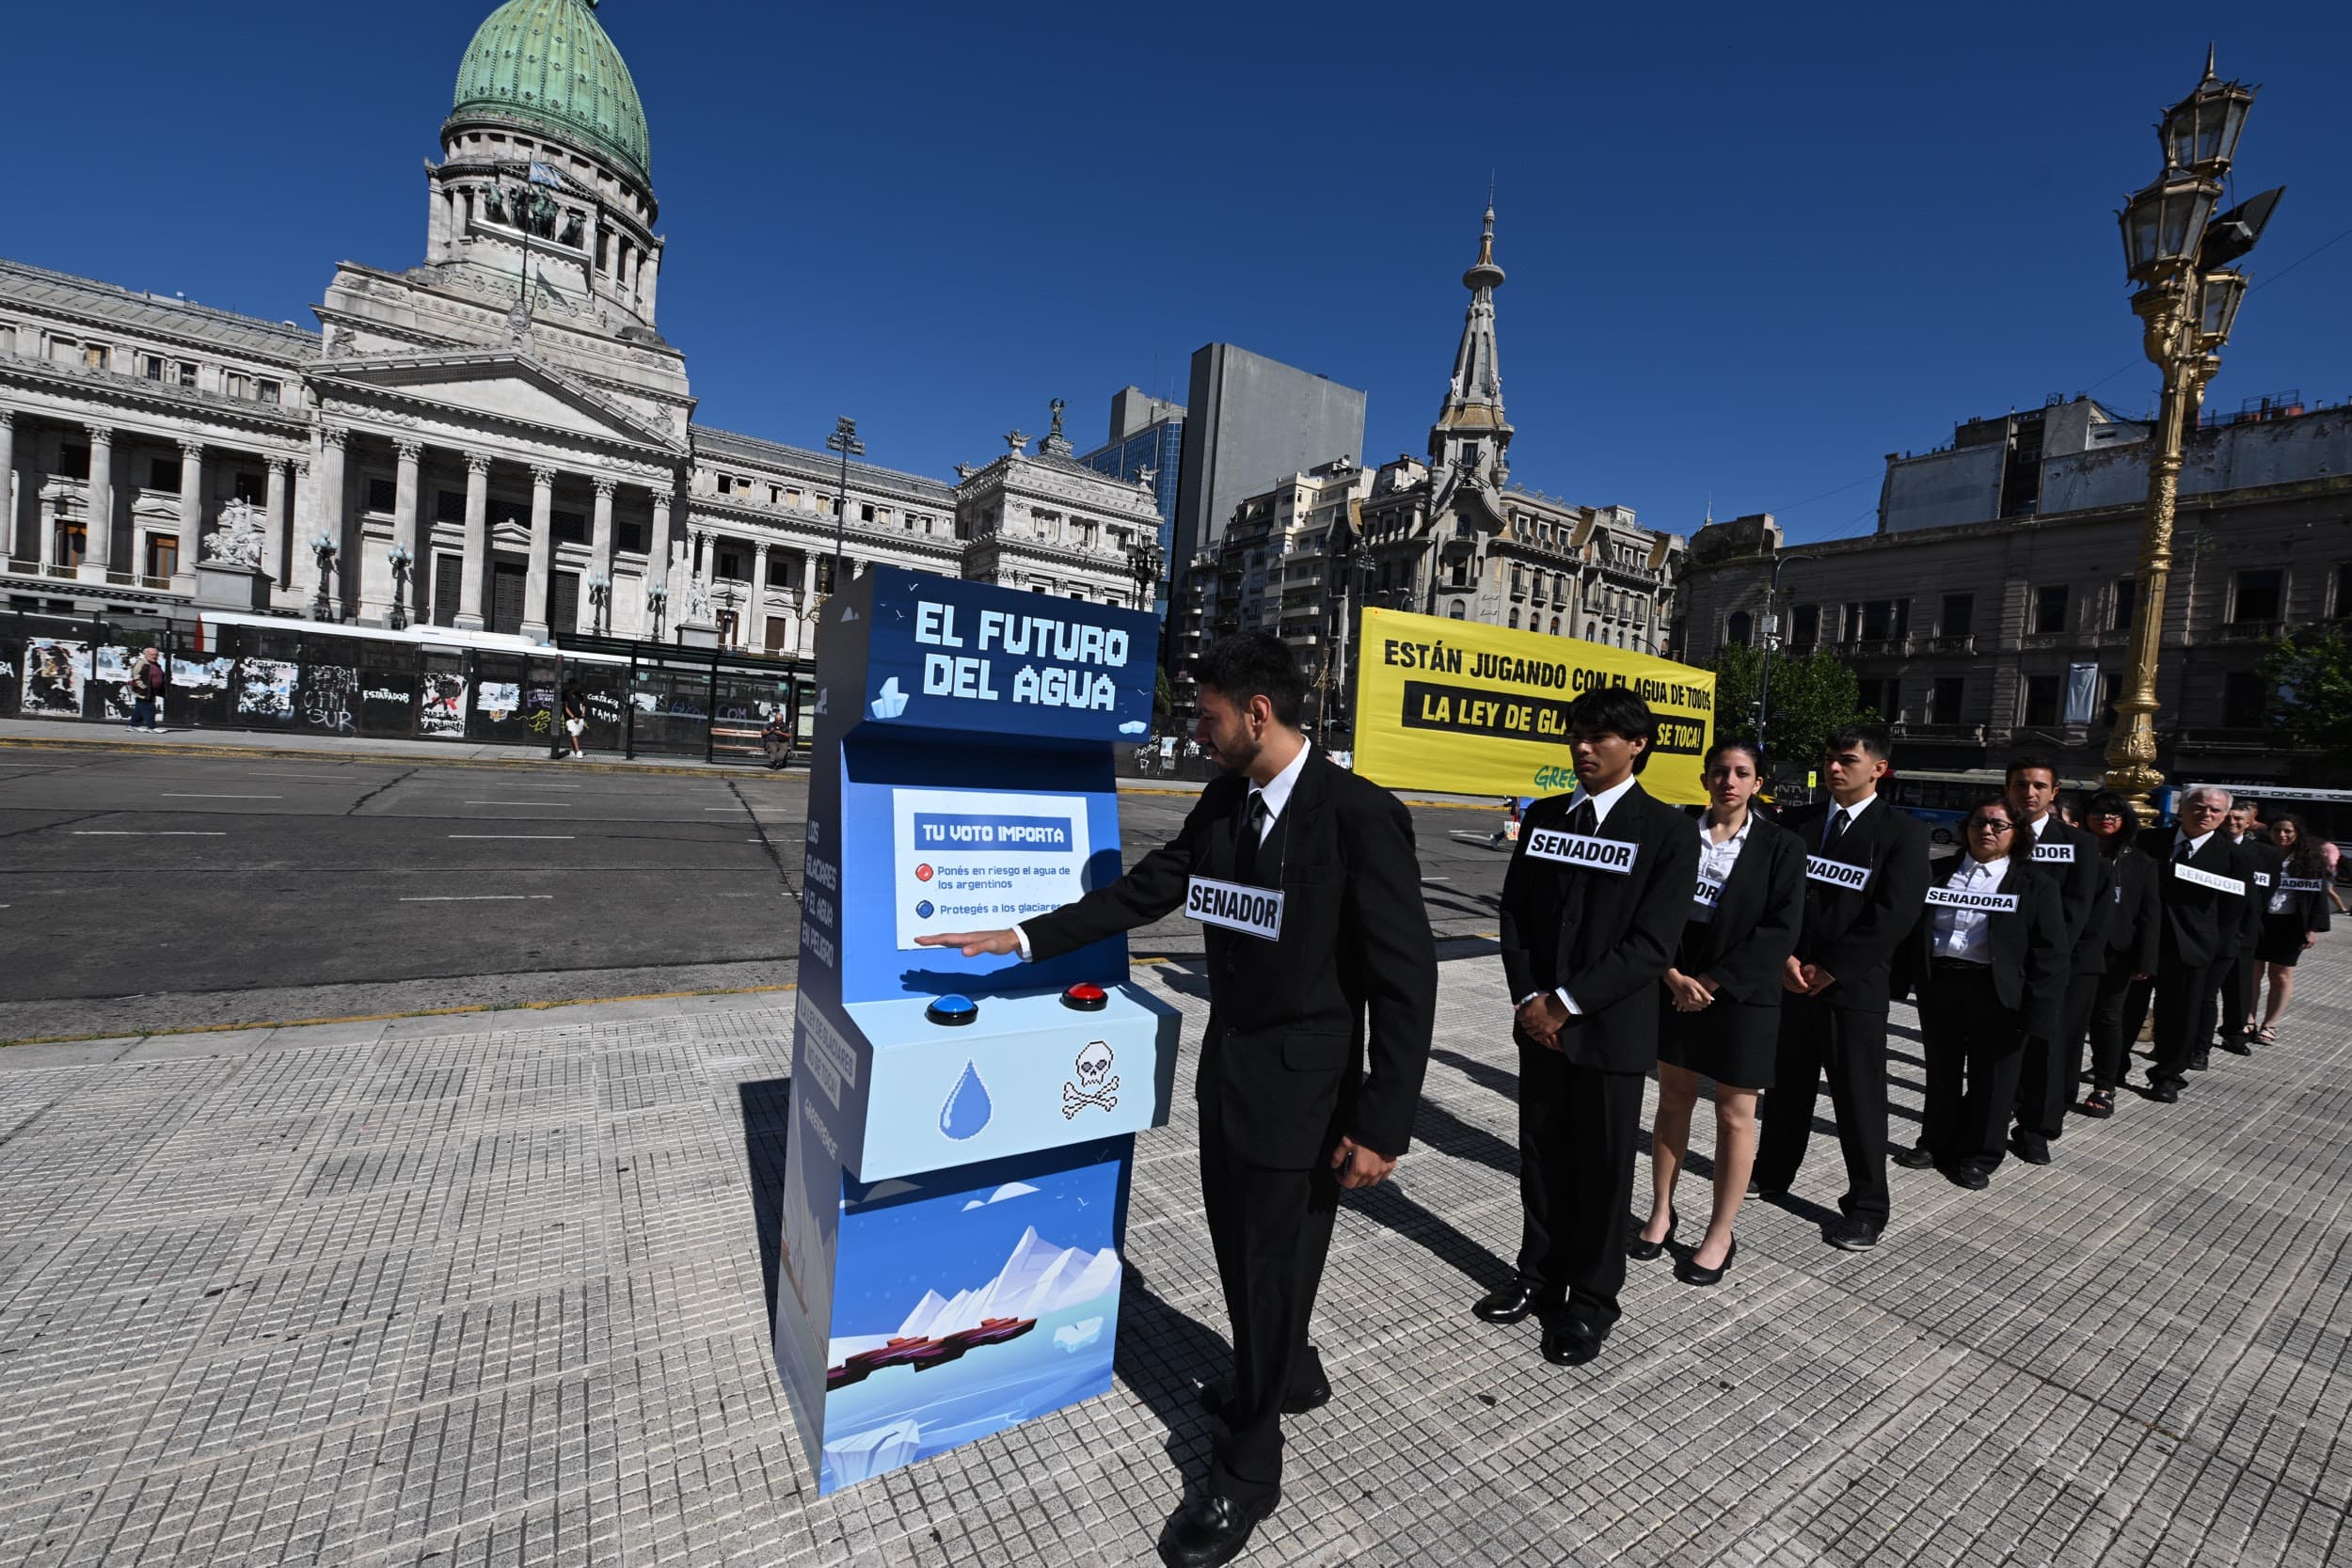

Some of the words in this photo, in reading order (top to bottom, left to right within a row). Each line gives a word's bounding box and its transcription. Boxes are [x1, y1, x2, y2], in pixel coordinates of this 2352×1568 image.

[915, 601, 963, 647] EL
[978, 610, 1129, 667] FUTURO
[923, 653, 998, 701] DEL
[1012, 665, 1116, 711] AGUA
[1385, 640, 1462, 674] ESTÁN
[1470, 653, 1566, 689] JUGANDO
[1572, 668, 1607, 690] CON
[1634, 677, 1667, 704] AGUA
[1671, 684, 1684, 705] DE
[1687, 687, 1710, 711] TODOS
[1422, 694, 1450, 722] LA
[1458, 699, 1500, 727] LEY
[1504, 704, 1532, 731] DE
[1657, 722, 1672, 746] SE
[1675, 725, 1701, 749] TOCA!
[1534, 766, 1578, 791] GREE
[807, 820, 819, 844] LOS
[923, 824, 945, 841] TU
[949, 824, 993, 842] VOTO
[998, 826, 1064, 843] IMPORTA
[1532, 833, 1630, 866] SENADOR
[806, 854, 836, 891] GLACIARES
[938, 865, 969, 876] Ponés
[973, 867, 985, 876] en
[989, 865, 1020, 877] riesgo
[1023, 865, 1031, 875] el
[1033, 867, 1056, 877] agua
[1058, 866, 1070, 875] de
[938, 879, 953, 889] los
[956, 879, 1012, 890] argentinos
[1806, 859, 1865, 886] NADOR
[2177, 866, 2243, 893] SENADOR
[2281, 879, 2320, 889] ADORA
[804, 888, 809, 910] Y
[809, 891, 816, 916] EL
[817, 898, 834, 928] AGUA
[940, 903, 989, 914] Protegés
[1001, 904, 1015, 912] los
[1189, 884, 1279, 929] SENADOR
[1929, 891, 2013, 909] SENADORA
[802, 921, 810, 948] EN
[810, 927, 834, 969] PELIGRO
[806, 1043, 814, 1064] NO
[821, 1024, 853, 1078] GLACIARES
